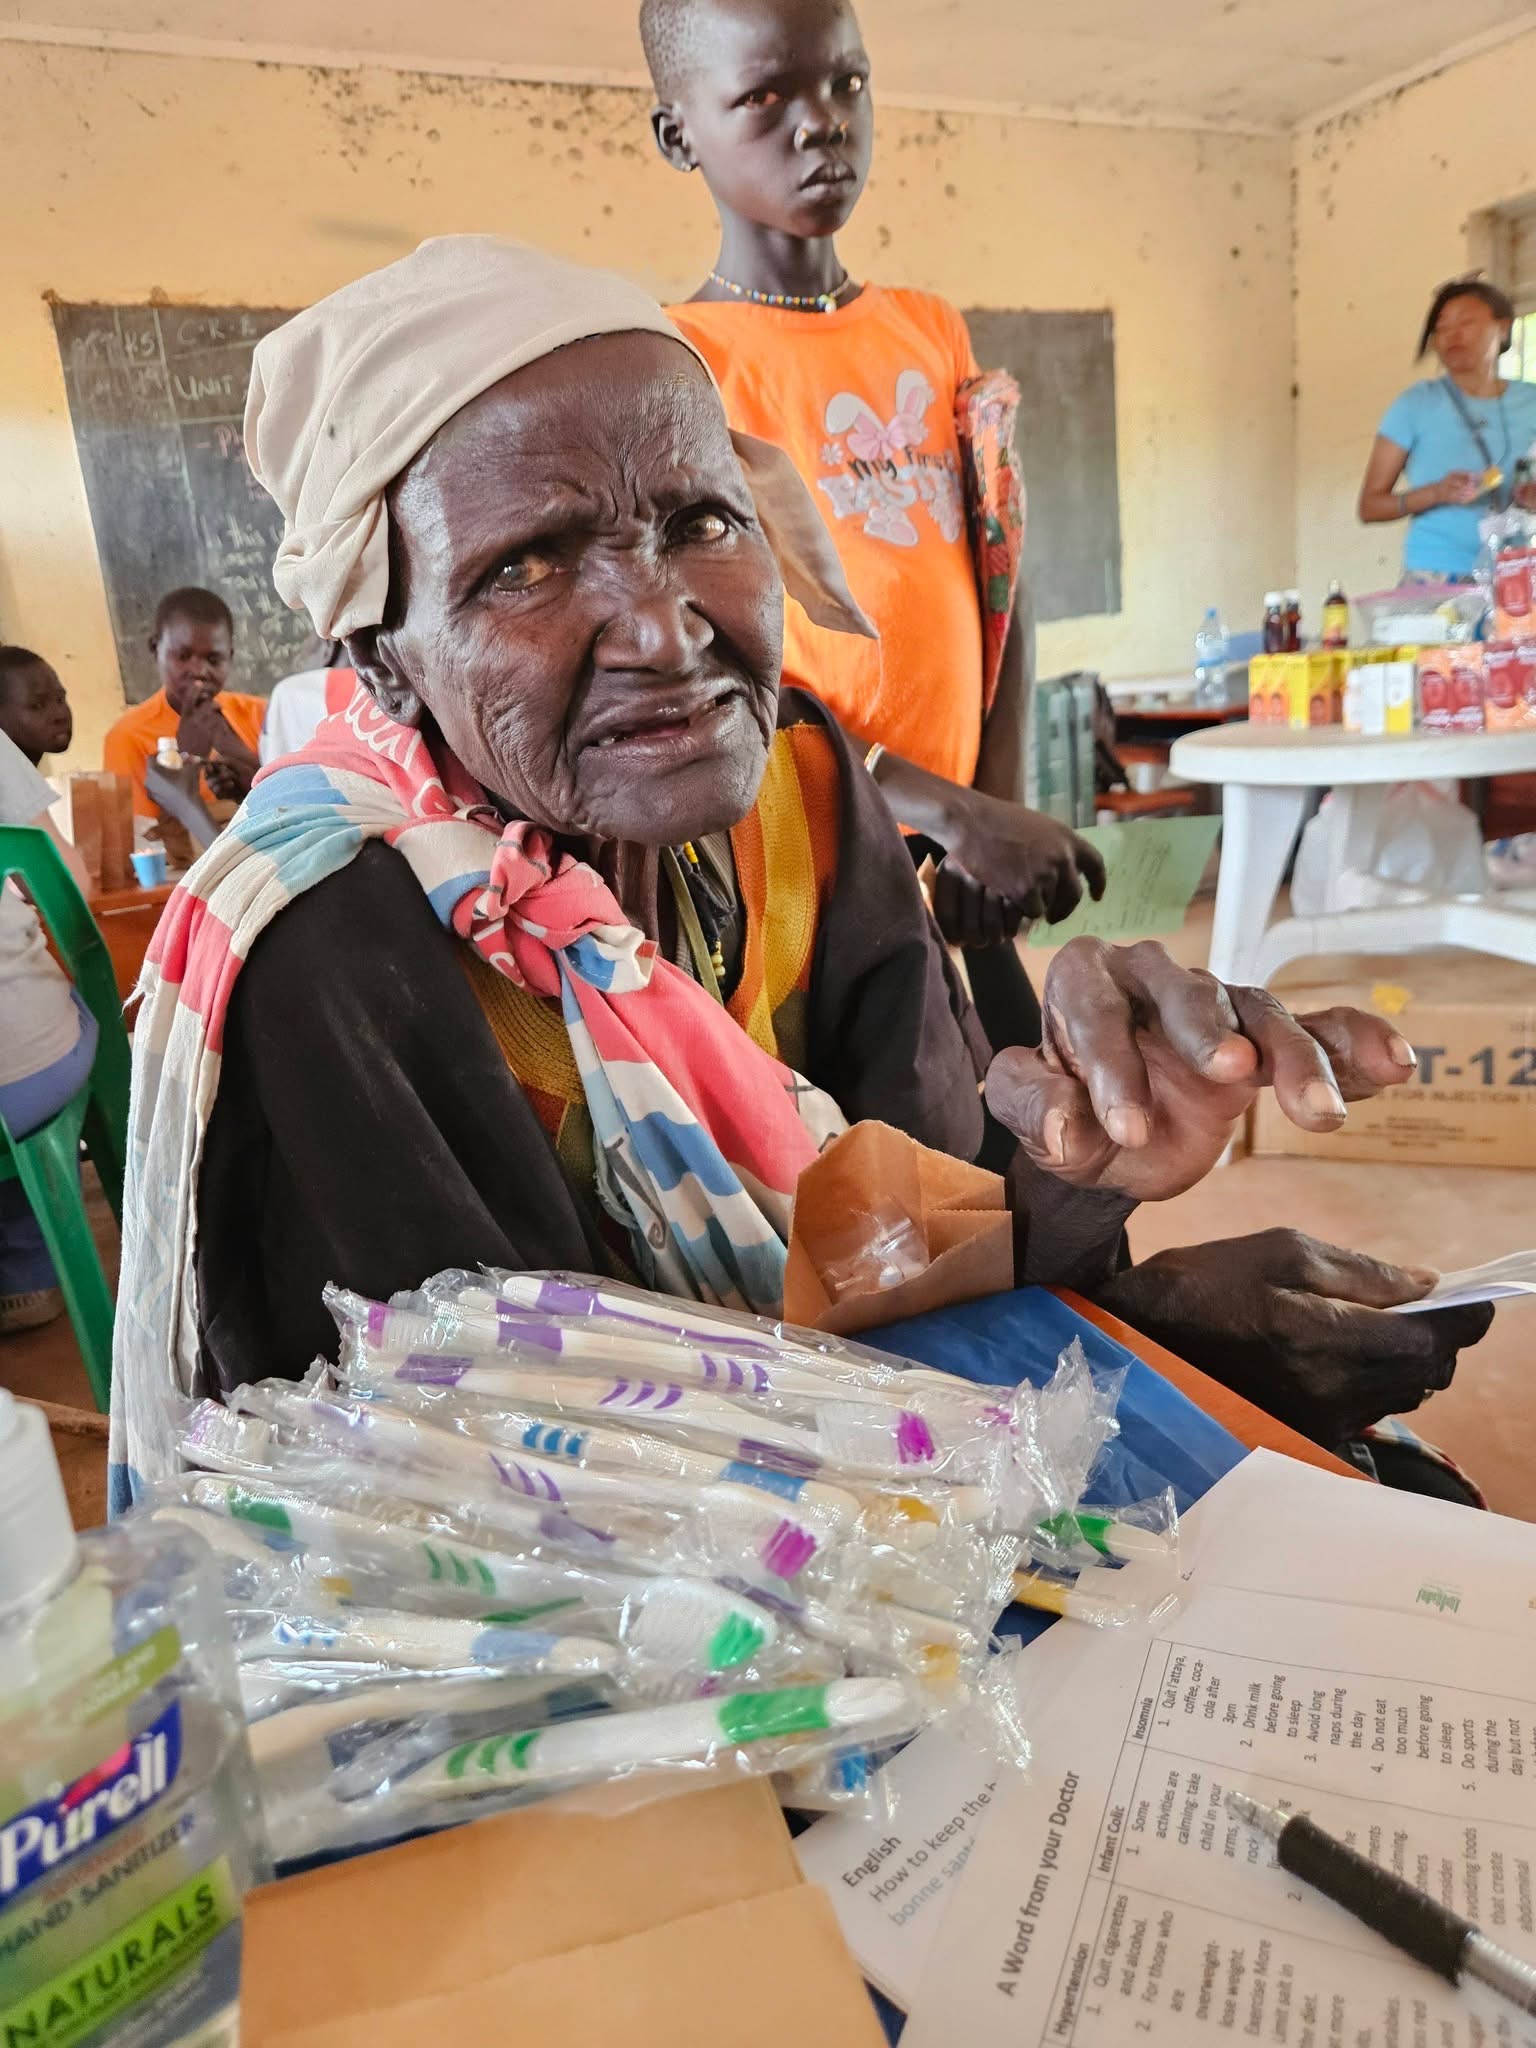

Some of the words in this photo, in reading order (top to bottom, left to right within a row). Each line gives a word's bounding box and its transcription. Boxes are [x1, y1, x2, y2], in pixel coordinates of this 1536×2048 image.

[1162, 1688, 1177, 1709] Quit
[1184, 1685, 1201, 1715] coffee,
[1209, 1676, 1221, 1700] after
[1248, 1682, 1262, 1705] milk
[1271, 1674, 1286, 1702] going
[1308, 1689, 1326, 1712] long
[1132, 1697, 1154, 1740] Insomnia
[1204, 1699, 1217, 1720] cola
[1223, 1703, 1238, 1725] 3pm
[1242, 1705, 1259, 1729] Drink
[1264, 1702, 1280, 1734] before
[1289, 1700, 1304, 1723] sleep
[1329, 1687, 1347, 1720] during
[1375, 1698, 1387, 1716] eat
[1417, 1694, 1434, 1723] going
[1286, 1724, 1298, 1738] to
[1306, 1713, 1321, 1743] Avoid
[1330, 1721, 1344, 1746] naps
[1350, 1710, 1367, 1729] day
[1374, 1716, 1386, 1735] not
[1394, 1706, 1408, 1735] much
[1462, 1718, 1478, 1751] sports
[1483, 1719, 1497, 1737] the
[1508, 1717, 1521, 1737] not
[1349, 1729, 1363, 1749] the
[1371, 1737, 1385, 1752] Do
[1395, 1737, 1408, 1755] too
[1416, 1724, 1430, 1759] before
[1439, 1721, 1455, 1751] sleep
[1506, 1737, 1522, 1756] but
[1439, 1752, 1453, 1765] to
[1460, 1753, 1475, 1769] Do
[1484, 1738, 1501, 1774] during
[1508, 1757, 1525, 1777] day
[1048, 1770, 1081, 1827] Doctor
[1186, 1772, 1201, 1796] take
[1209, 1783, 1223, 1808] your
[0, 1731, 168, 1893] Purell
[1107, 1804, 1125, 1834] Colic
[1131, 1800, 1150, 1832] Some
[1155, 1789, 1177, 1839] activities
[1167, 1770, 1180, 1788] are
[1205, 1808, 1217, 1821] in
[869, 1865, 910, 1903] How
[906, 1849, 929, 1868] to
[922, 1815, 966, 1851] keep
[961, 1792, 992, 1817] the
[1038, 1828, 1064, 1871] your
[1199, 1821, 1216, 1852] child
[1223, 1825, 1240, 1858] arms,
[1463, 1827, 1478, 1860] foods
[841, 1835, 902, 1888] English
[1097, 1835, 1118, 1873] Infant
[1440, 1857, 1454, 1908] onsider
[1488, 1851, 1505, 1895] create
[888, 1876, 944, 1927] bonne
[1019, 1872, 1052, 1918] from
[1513, 1856, 1533, 1934] abdominal
[1157, 1910, 1175, 1938] who
[1489, 1896, 1506, 1926] that
[1001, 1920, 1036, 1975] Word
[1093, 1957, 1113, 1988] Quit
[1103, 1893, 1129, 1957] cigarettes
[5, 1882, 215, 2048] NATURALS
[1148, 1940, 1168, 1979] those
[1253, 1938, 1272, 1976] More
[996, 1980, 1018, 1998] A
[1053, 1942, 1091, 2036] Hypertension
[1119, 1967, 1136, 1997] and
[1141, 1980, 1159, 2003] For
[1170, 1988, 1186, 2013] are
[1243, 1979, 1267, 2037] Exercise
